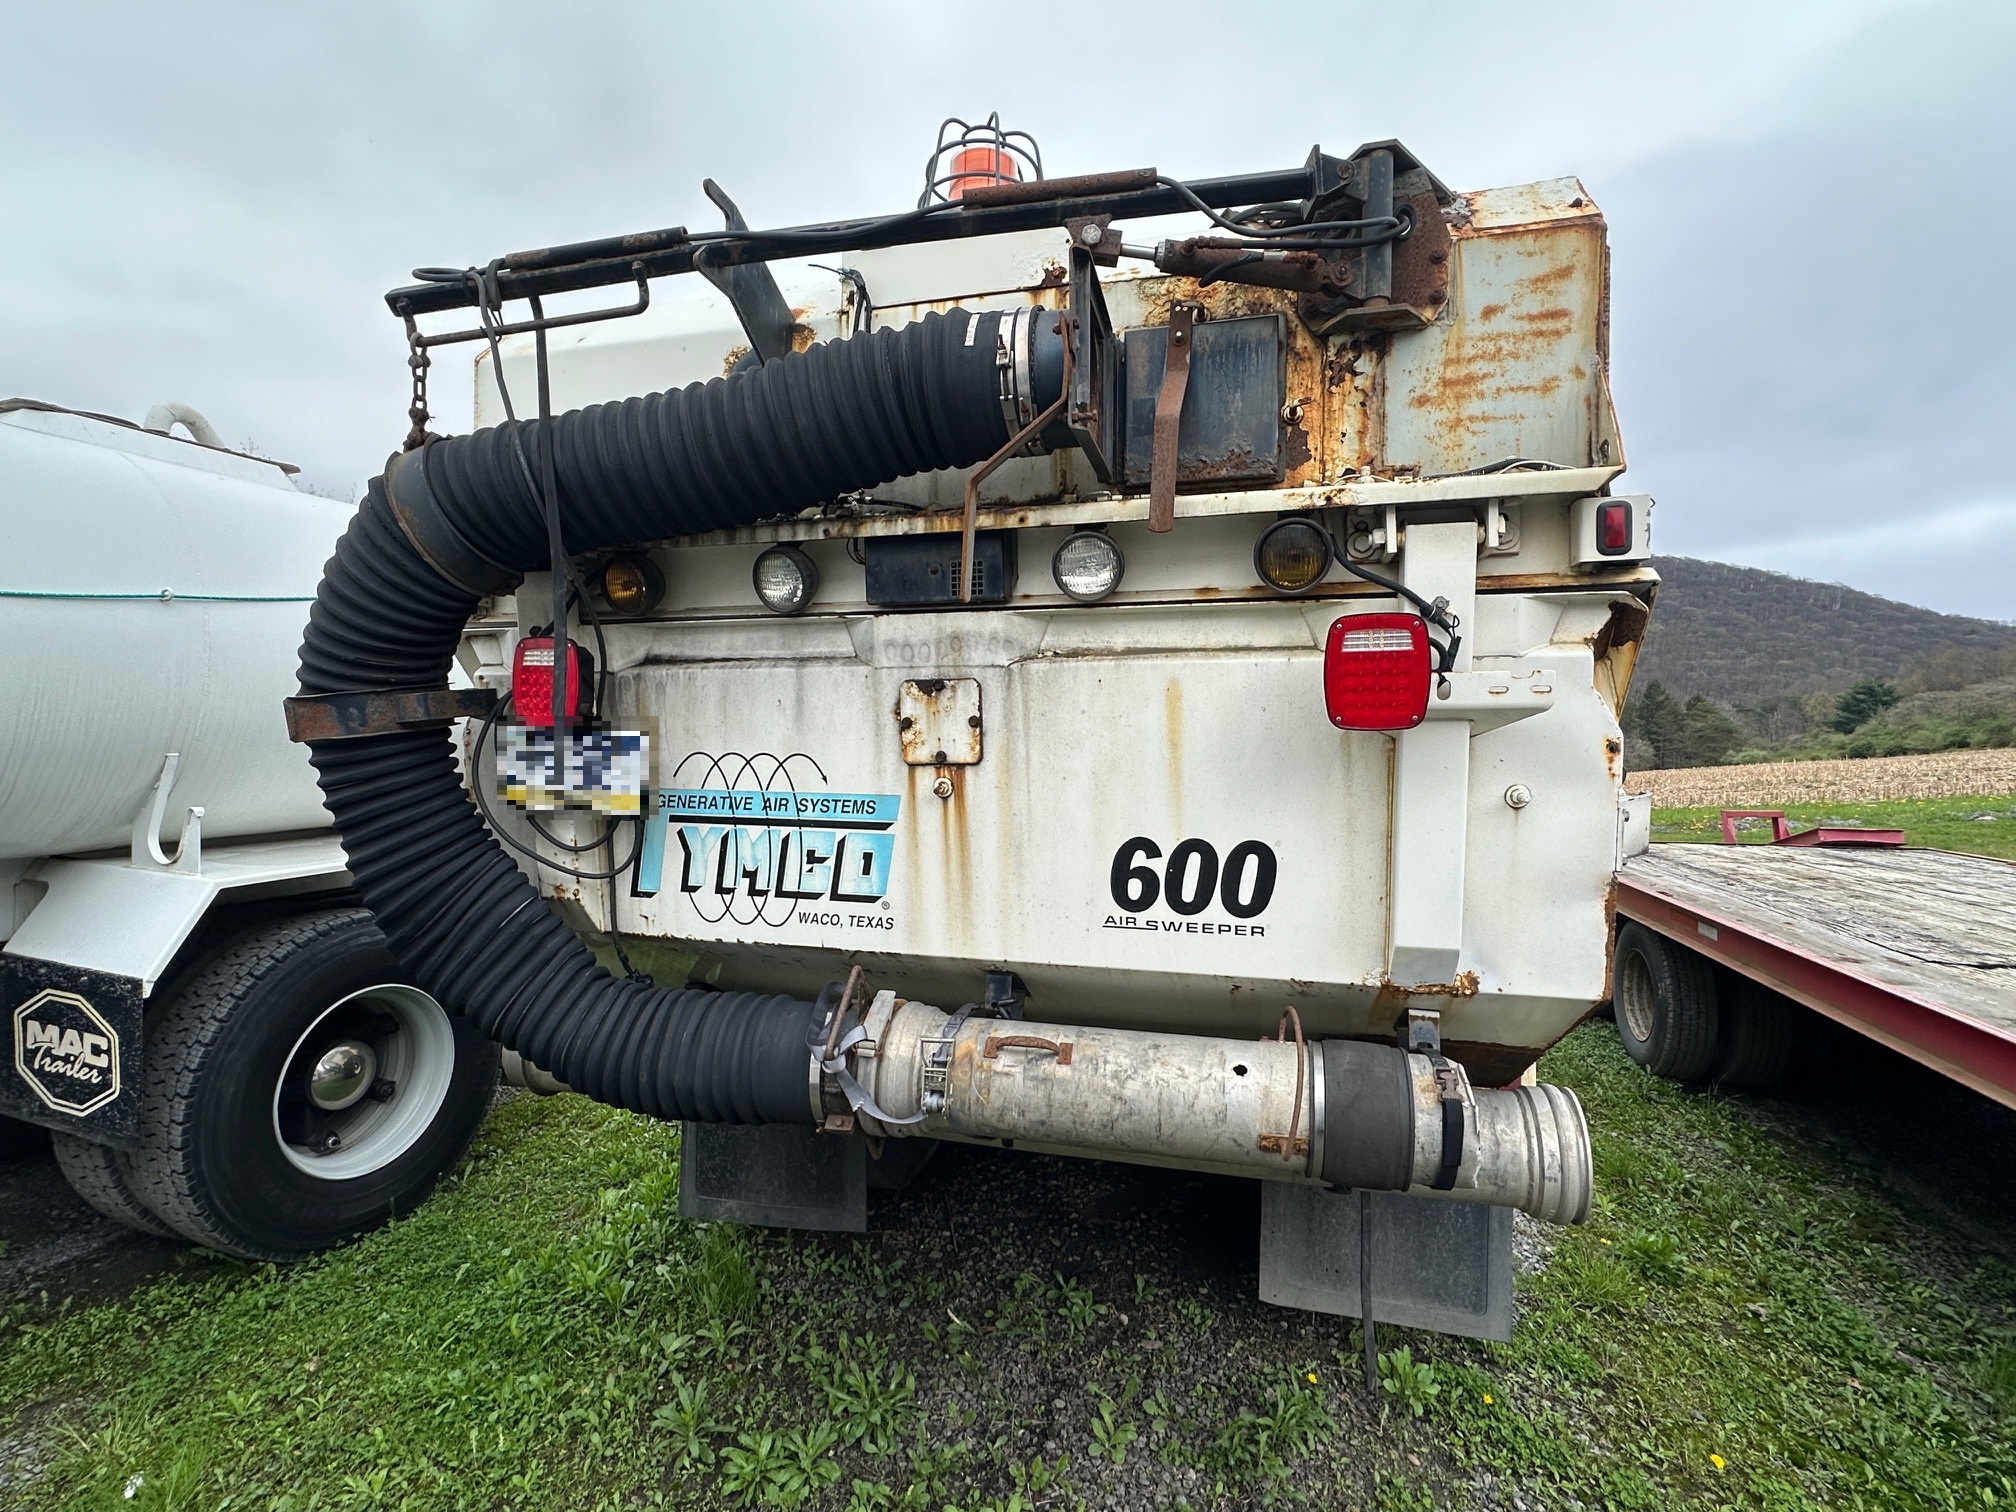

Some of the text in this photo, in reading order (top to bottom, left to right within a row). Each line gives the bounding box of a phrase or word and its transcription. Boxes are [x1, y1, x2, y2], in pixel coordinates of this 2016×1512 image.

[762, 797, 789, 812] AIR
[798, 798, 877, 815] SYSTEMS
[631, 822, 895, 902] TYMCO
[1110, 836, 1278, 919] 600
[798, 911, 895, 931] WACO, TEXAS
[1104, 915, 1265, 937] AIR SWEEPER
[26, 1019, 109, 1068] MAC
[30, 1042, 102, 1084] Trailer
